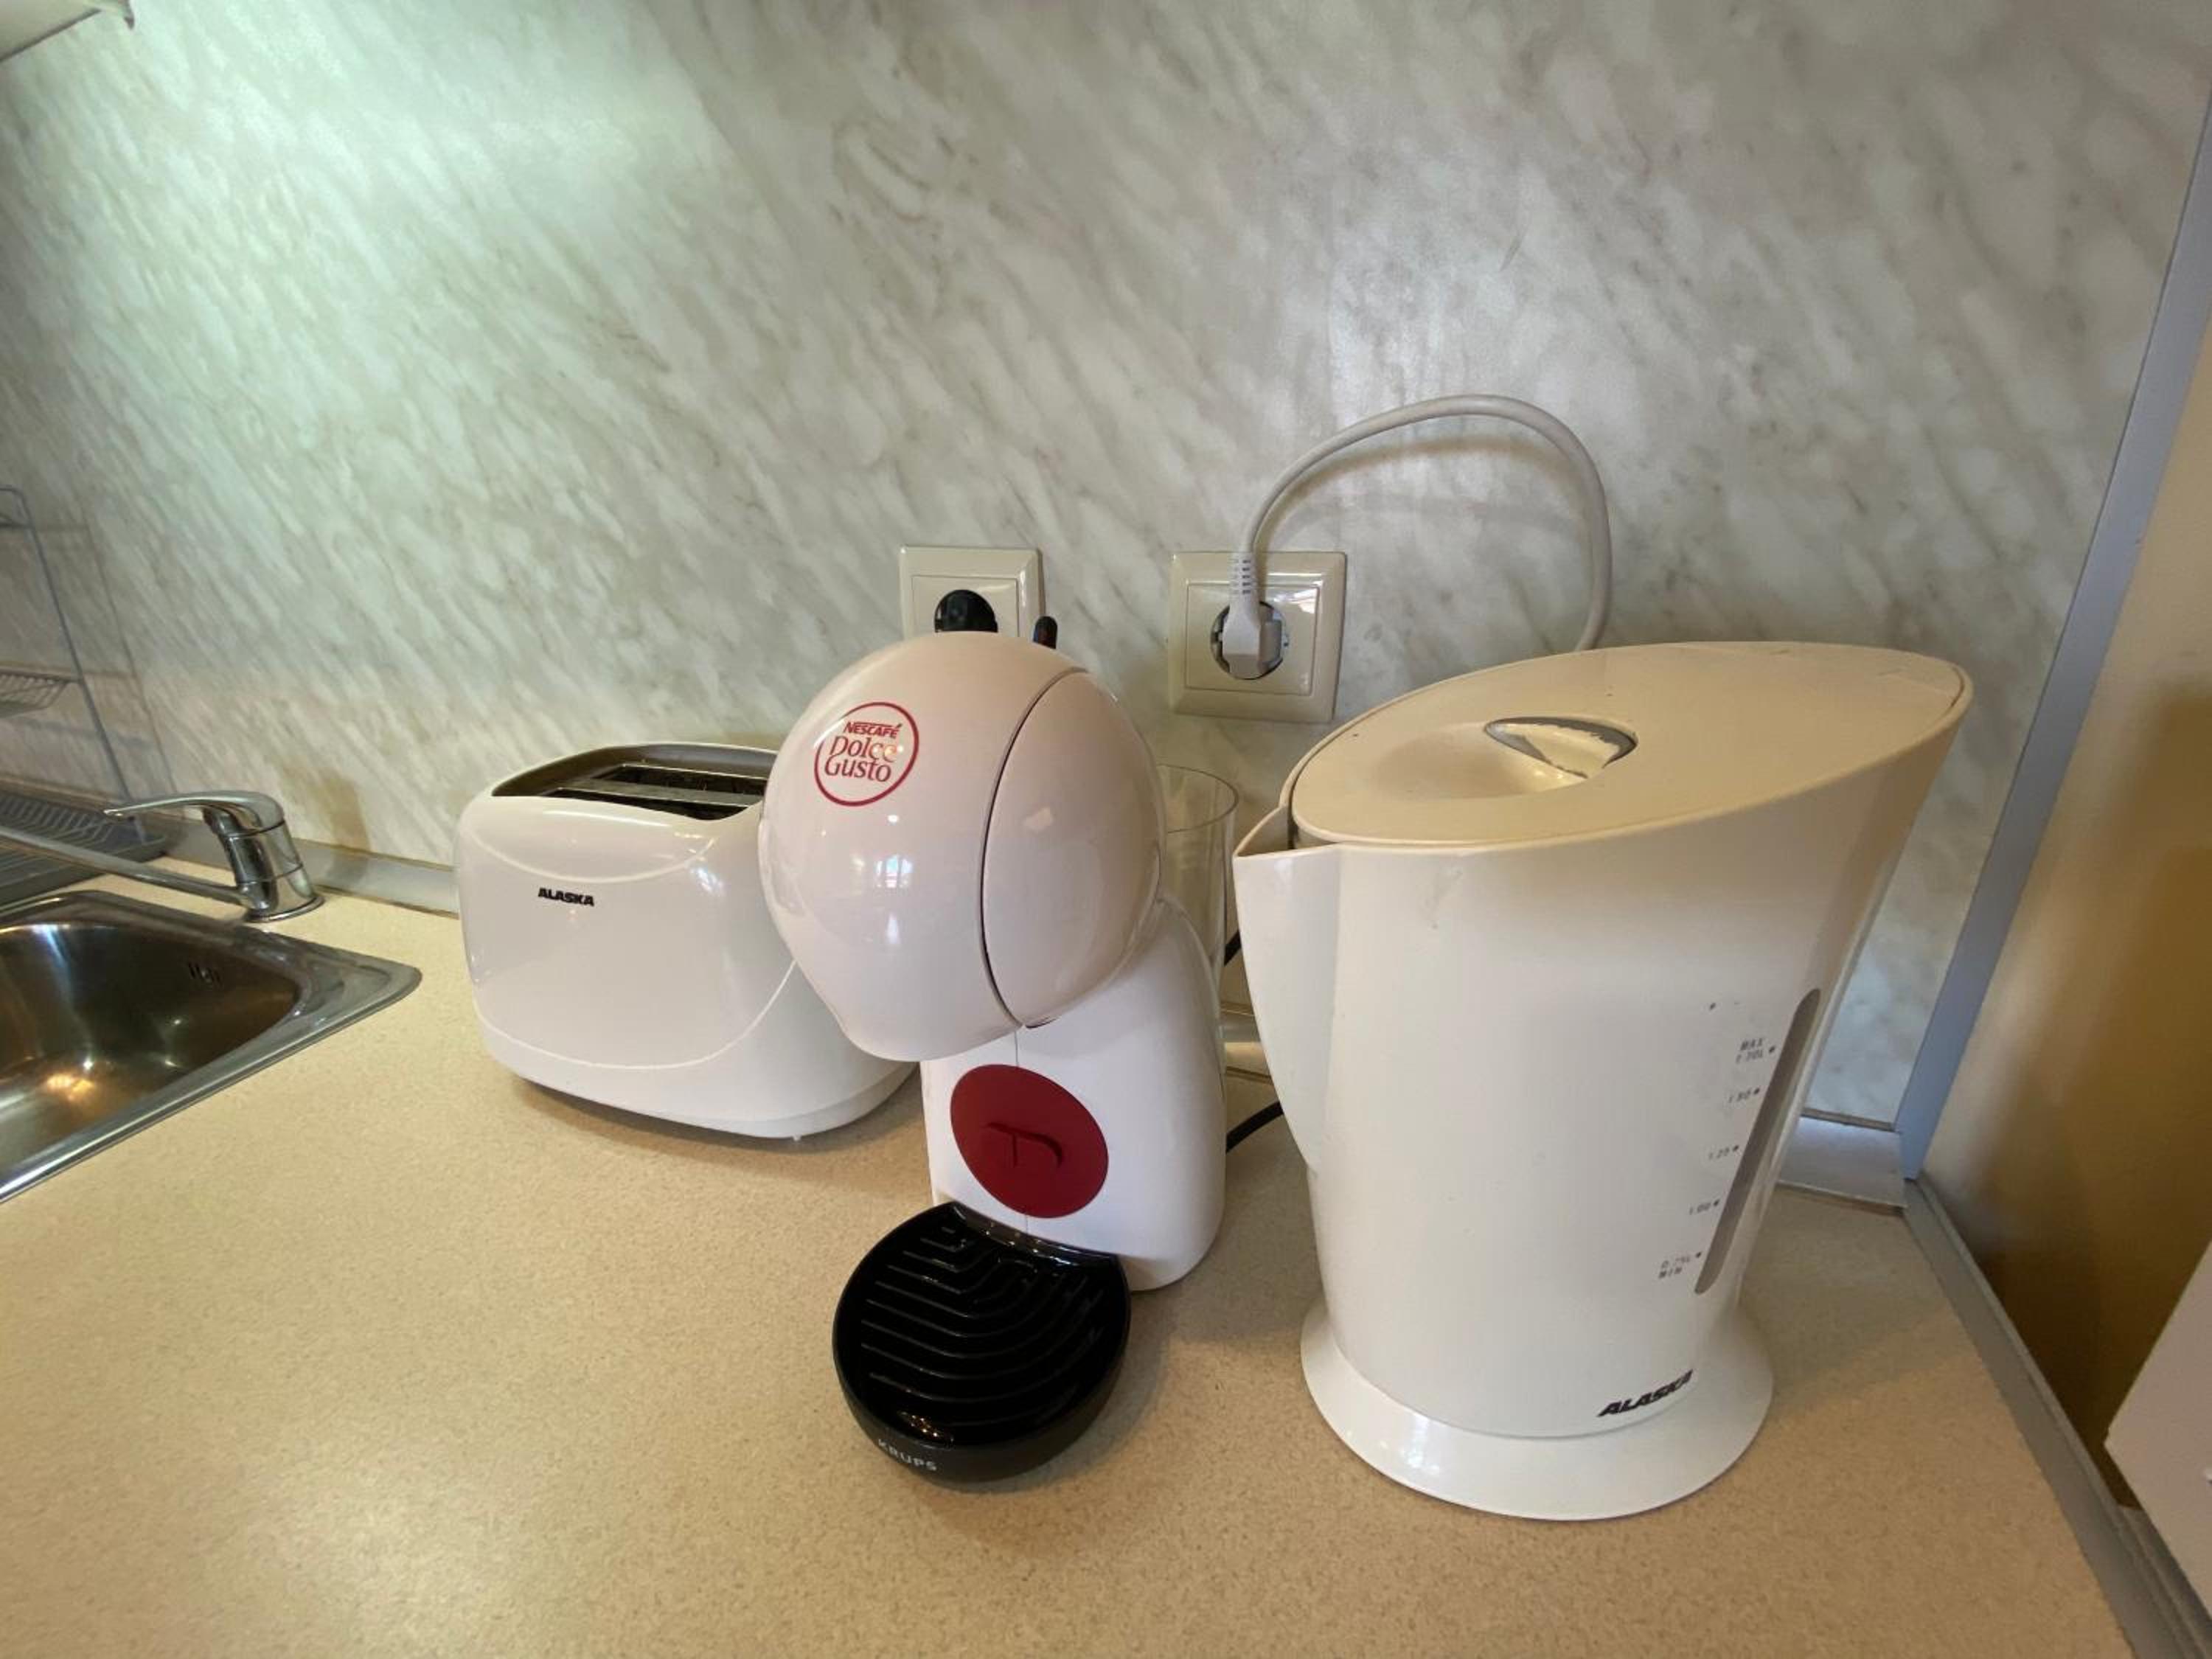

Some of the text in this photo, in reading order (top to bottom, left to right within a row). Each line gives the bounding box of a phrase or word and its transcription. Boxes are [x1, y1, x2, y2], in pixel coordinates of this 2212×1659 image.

[844, 721, 902, 739] NESCAFÉ
[830, 736, 897, 763] Dolce
[824, 753, 892, 782] Gusto
[538, 887, 595, 907] ALASKA
[1596, 1368, 1694, 1417] ALASKA
[877, 1439, 937, 1471] KRUPS
